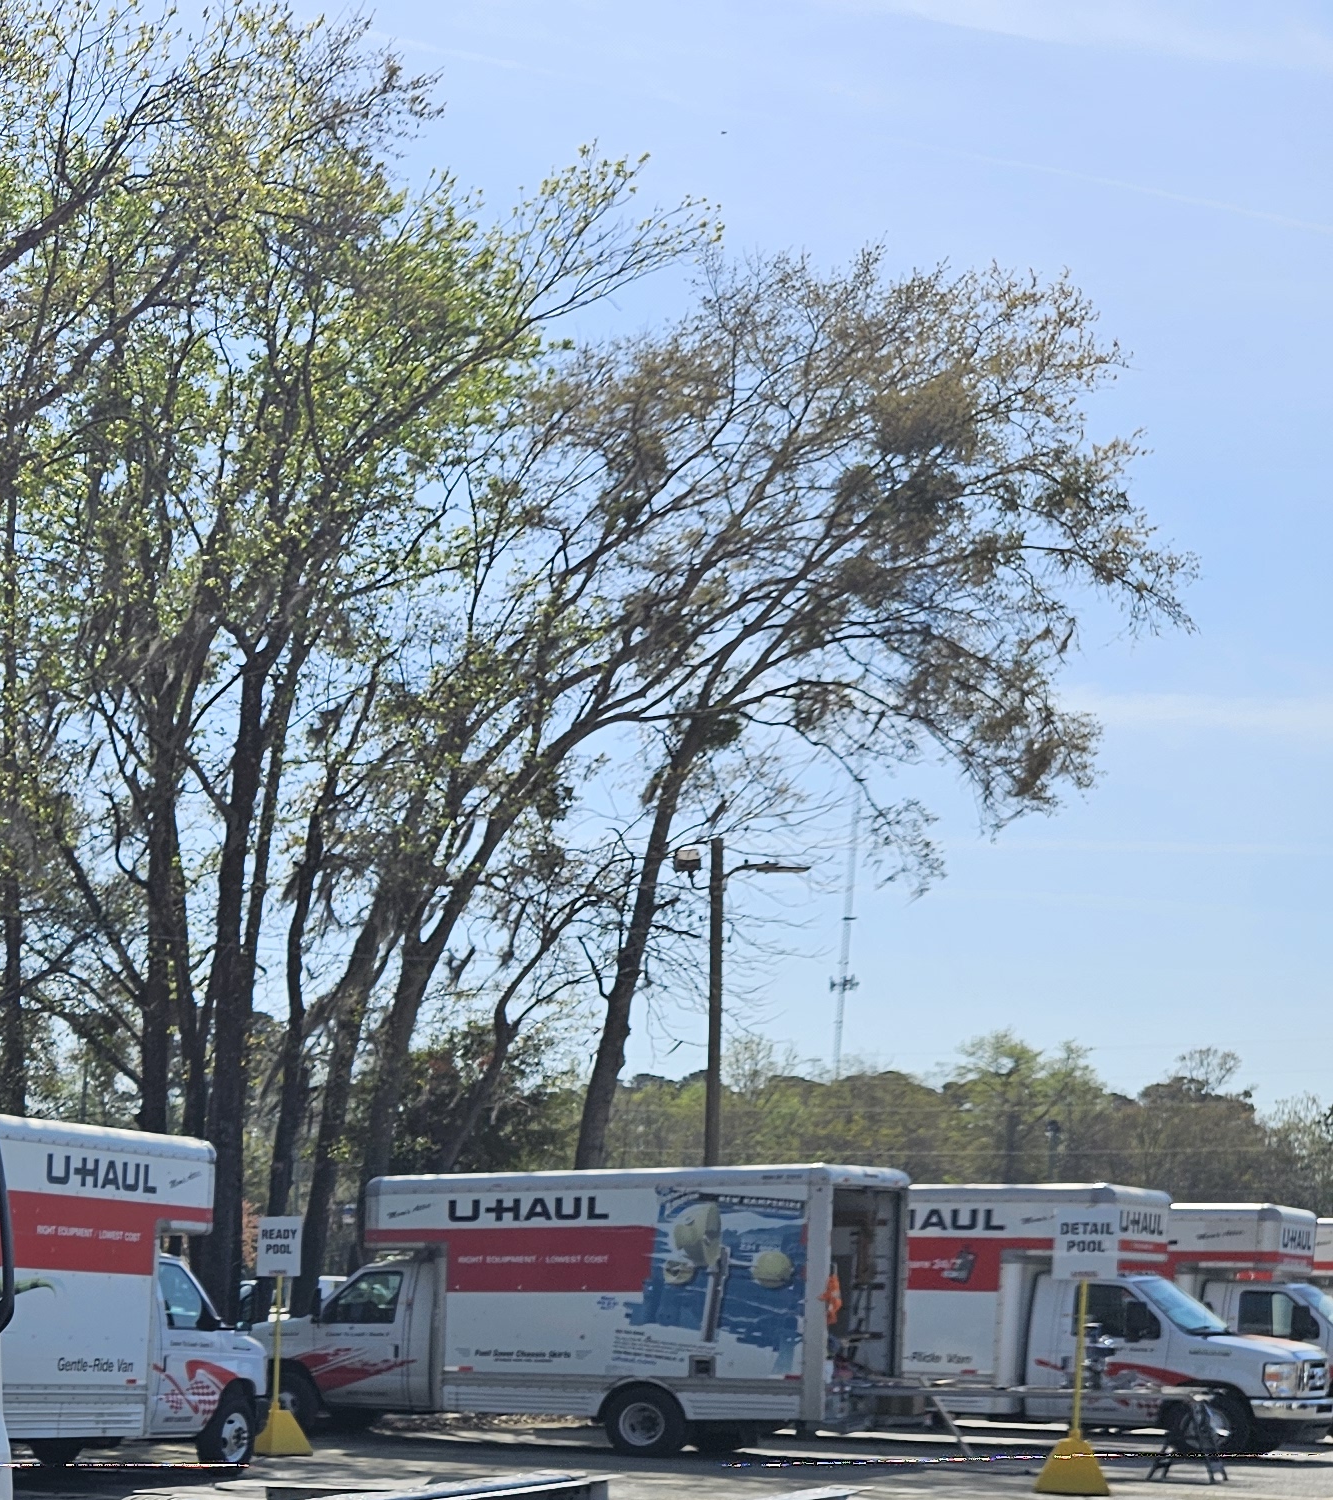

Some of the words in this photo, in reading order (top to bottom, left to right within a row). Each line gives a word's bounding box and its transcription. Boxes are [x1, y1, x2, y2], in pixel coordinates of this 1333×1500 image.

[46, 1153, 158, 1195] U-HAUL
[448, 1196, 610, 1222] U-HAUL
[1060, 1222, 1114, 1235] DETAIL
[1118, 1210, 1164, 1236] U-HAUL
[261, 1229, 297, 1240] READY
[265, 1244, 292, 1255] POOL
[1066, 1240, 1105, 1253] POOL
[57, 1357, 114, 1373] Gentle-Ride
[117, 1358, 134, 1373] Van
